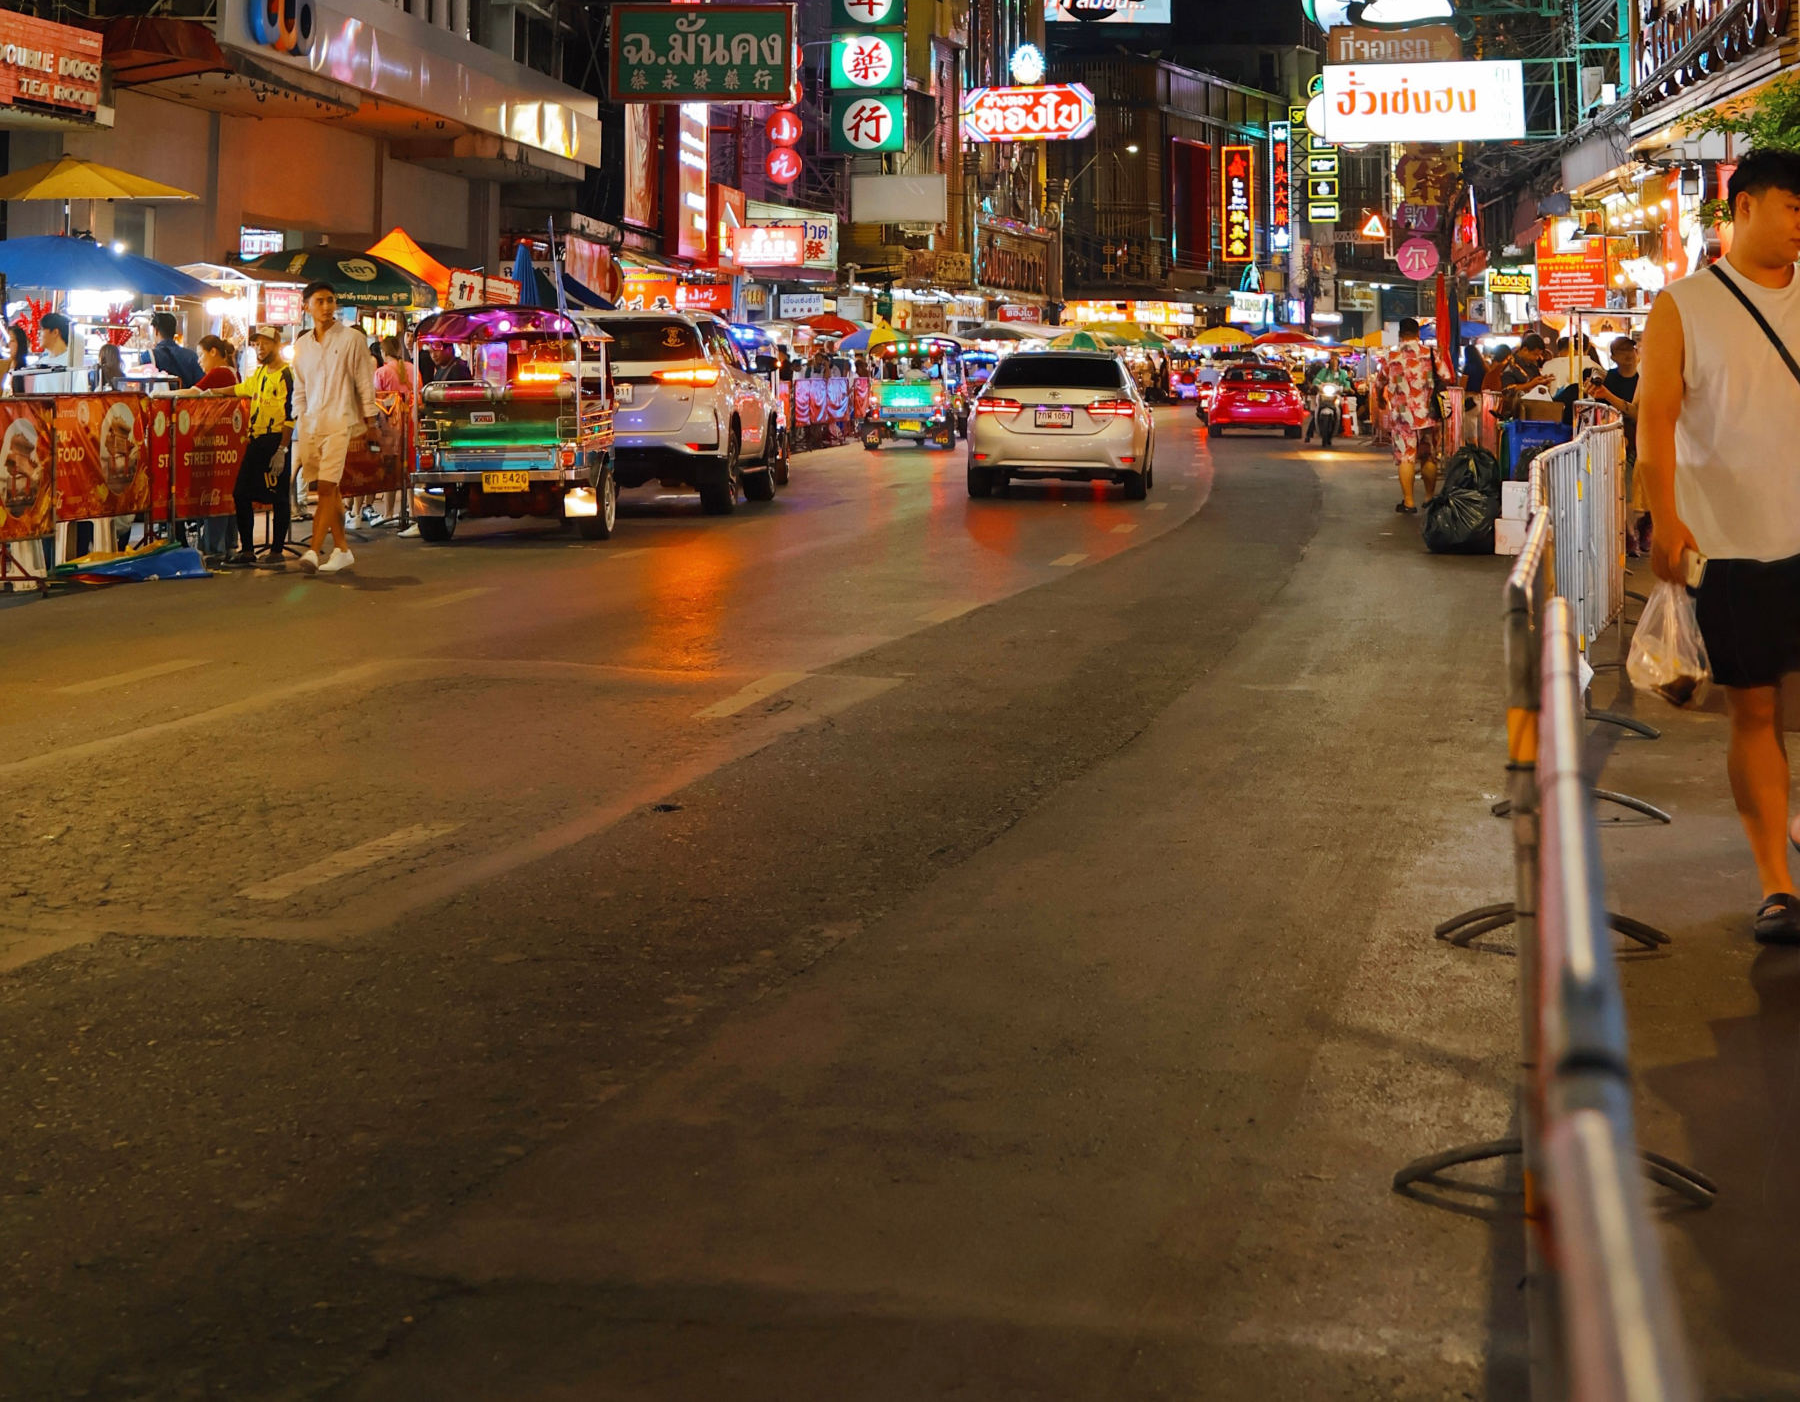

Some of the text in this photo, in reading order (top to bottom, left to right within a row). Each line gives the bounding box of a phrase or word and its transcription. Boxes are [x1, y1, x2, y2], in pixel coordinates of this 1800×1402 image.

[623, 13, 782, 66] ฉ.มั่นคง
[1340, 31, 1430, 60] ที่จอดรถ
[58, 57, 100, 83] DOGS
[19, 78, 49, 96] TEA
[57, 446, 85, 463] FOOD
[184, 450, 238, 466] STREET FOOD
